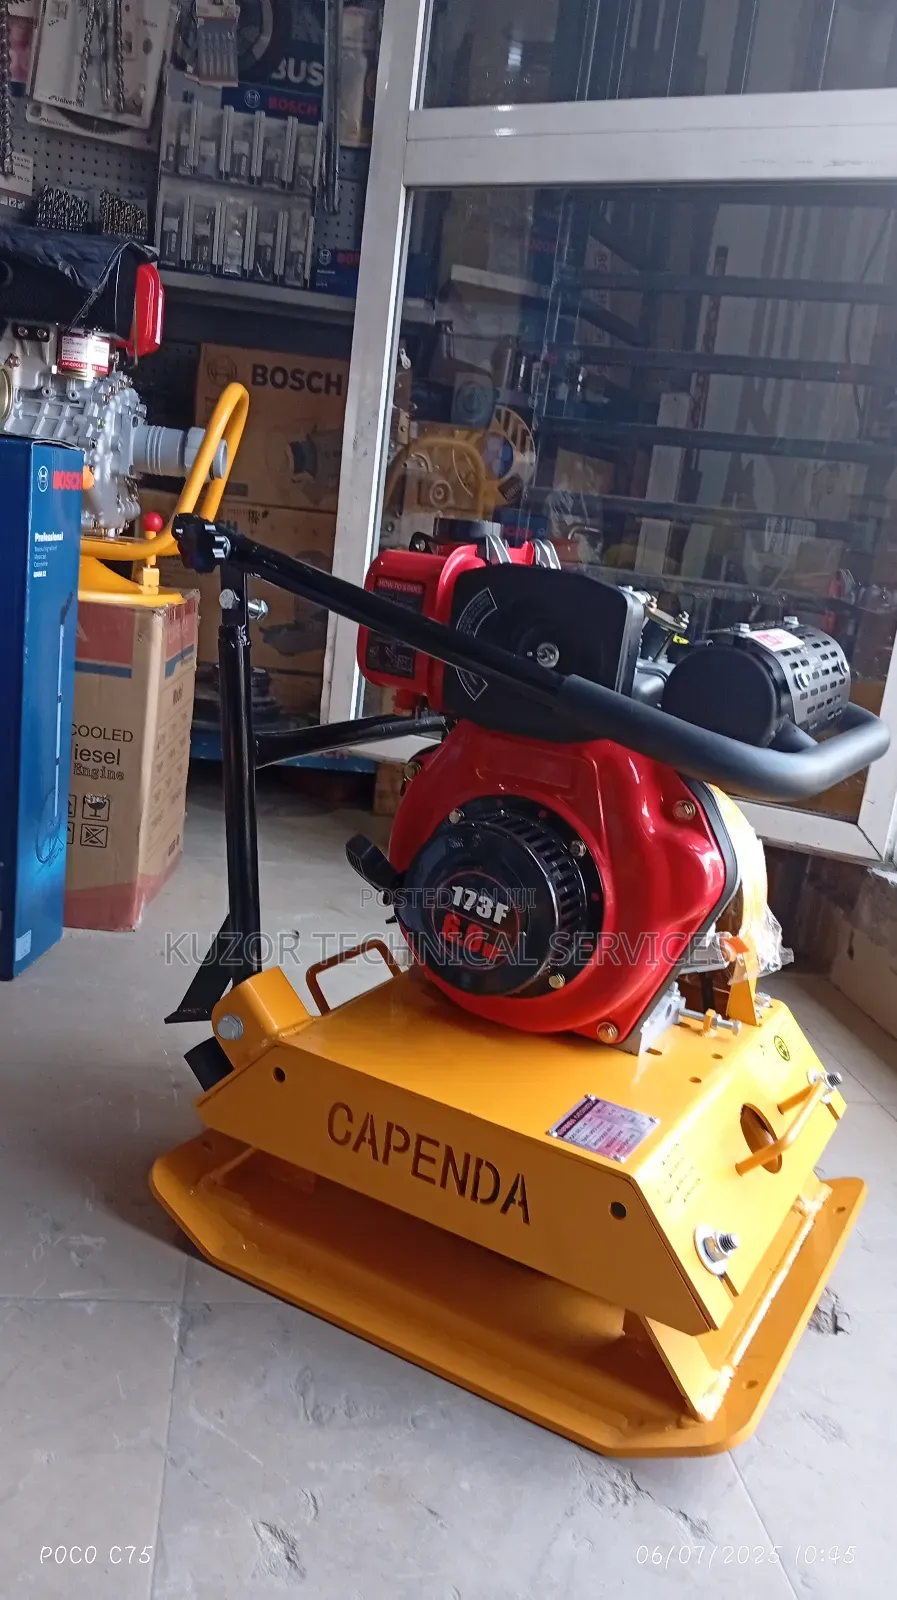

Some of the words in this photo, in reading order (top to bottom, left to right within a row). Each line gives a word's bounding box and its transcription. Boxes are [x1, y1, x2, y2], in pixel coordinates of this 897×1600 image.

[268, 96, 319, 117] BOSCH
[251, 363, 342, 396] BOSCH
[53, 470, 83, 490] BOSCH
[34, 531, 64, 542] Professional
[74, 743, 121, 765] iesel
[73, 762, 125, 781] Engine
[452, 885, 509, 924] 173F
[327, 1101, 531, 1226] CAPENDA
